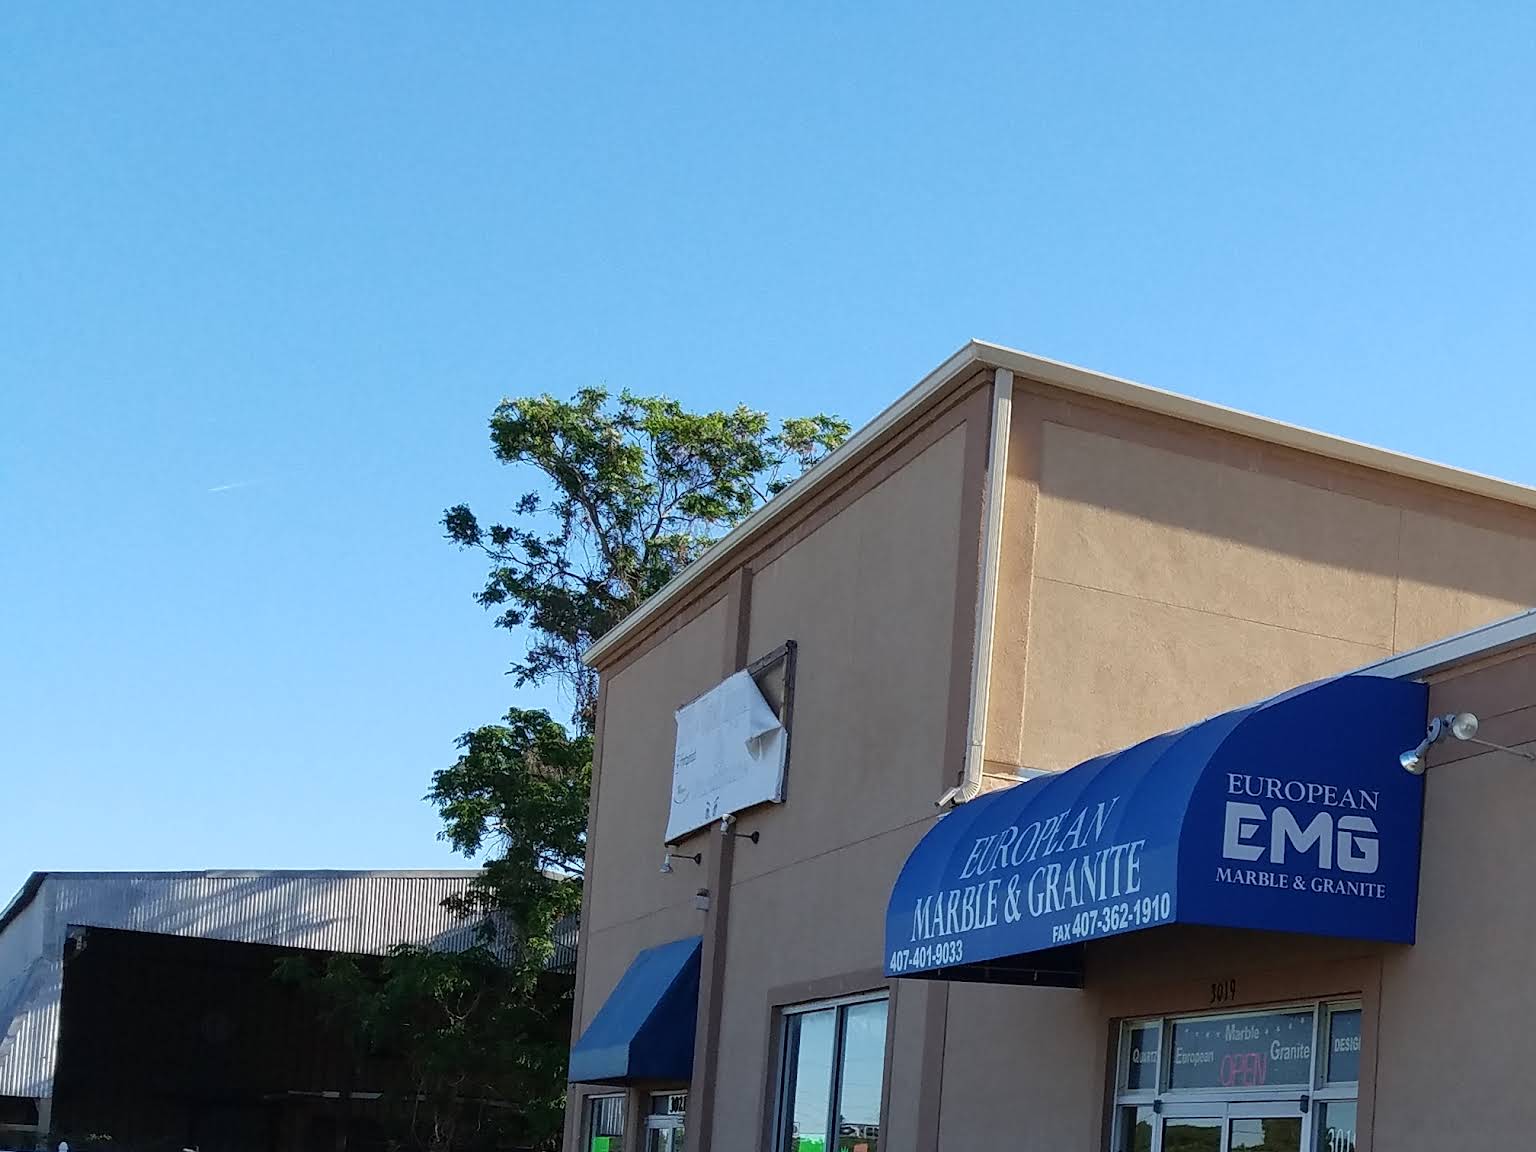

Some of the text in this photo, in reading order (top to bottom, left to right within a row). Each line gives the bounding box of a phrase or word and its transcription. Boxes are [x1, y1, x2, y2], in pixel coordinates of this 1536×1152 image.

[1227, 773, 1380, 811] EUROPEAN
[959, 796, 1120, 880] EUROPEAN
[1222, 801, 1380, 874] EMG
[910, 839, 1146, 943] MARBLE & GRANITE
[1215, 867, 1386, 899] MARBLE & GRANITE
[1052, 892, 1171, 943] FAX 407-362-1910
[890, 939, 963, 972] 407-401-9033
[1210, 979, 1236, 1004] 3019
[1225, 1024, 1260, 1041] Marble
[1334, 1036, 1361, 1052] DESIG
[1270, 1039, 1310, 1061] Granite
[1219, 1053, 1267, 1087] OPEN
